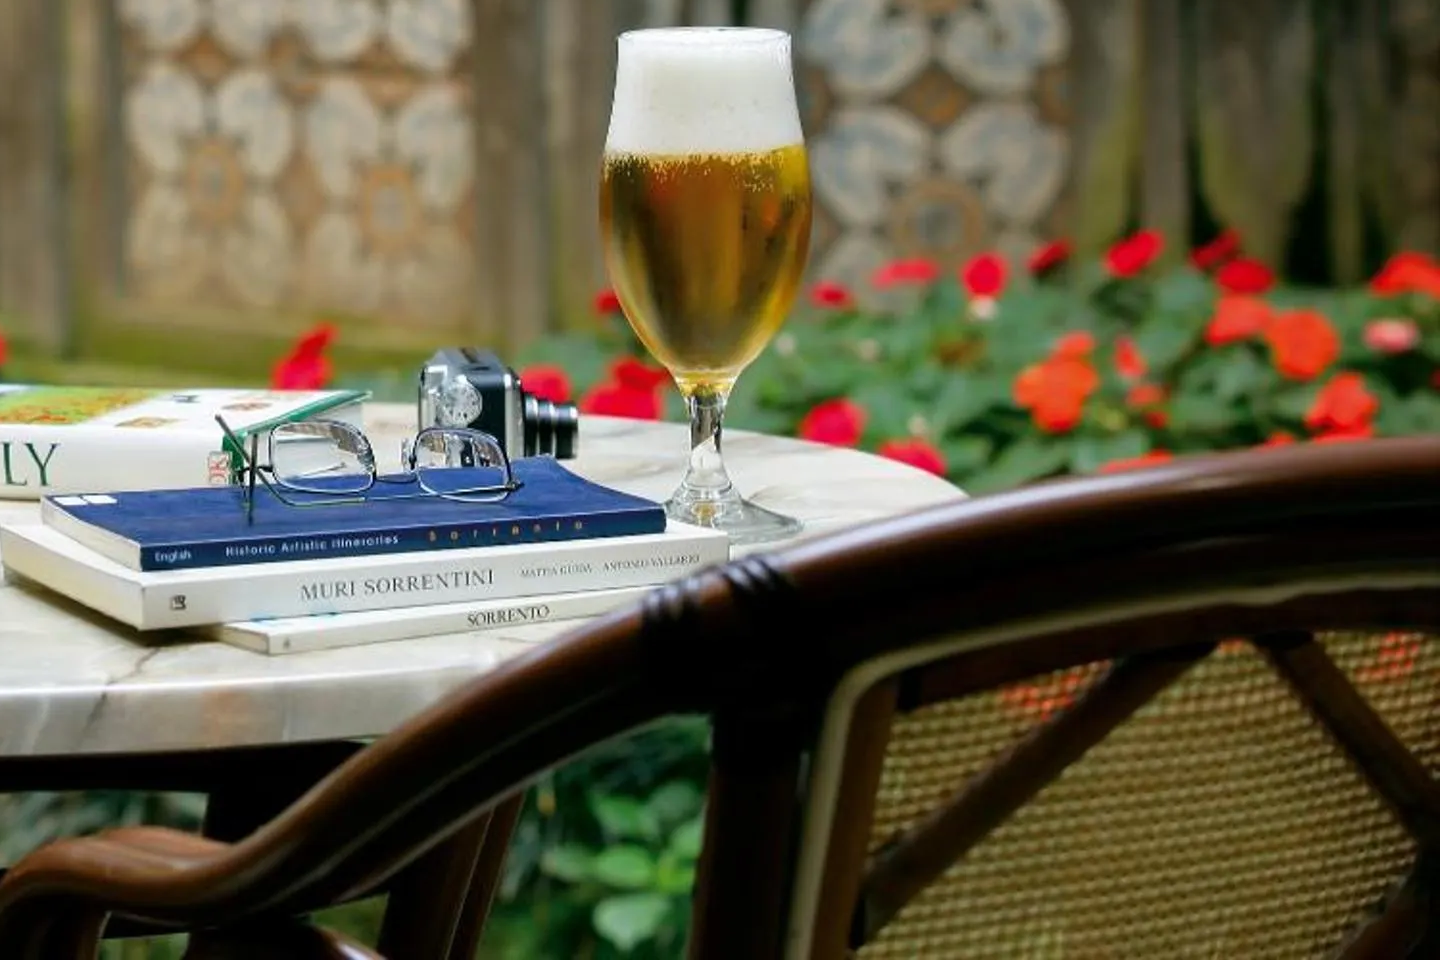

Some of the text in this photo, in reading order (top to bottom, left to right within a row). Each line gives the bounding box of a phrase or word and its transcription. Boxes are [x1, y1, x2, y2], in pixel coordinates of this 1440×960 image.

[154, 548, 192, 563] English
[225, 535, 399, 557] Historic Artistic Itineraries
[300, 568, 494, 601] MURI SORRENTINI
[467, 604, 550, 627] SORRENTO
